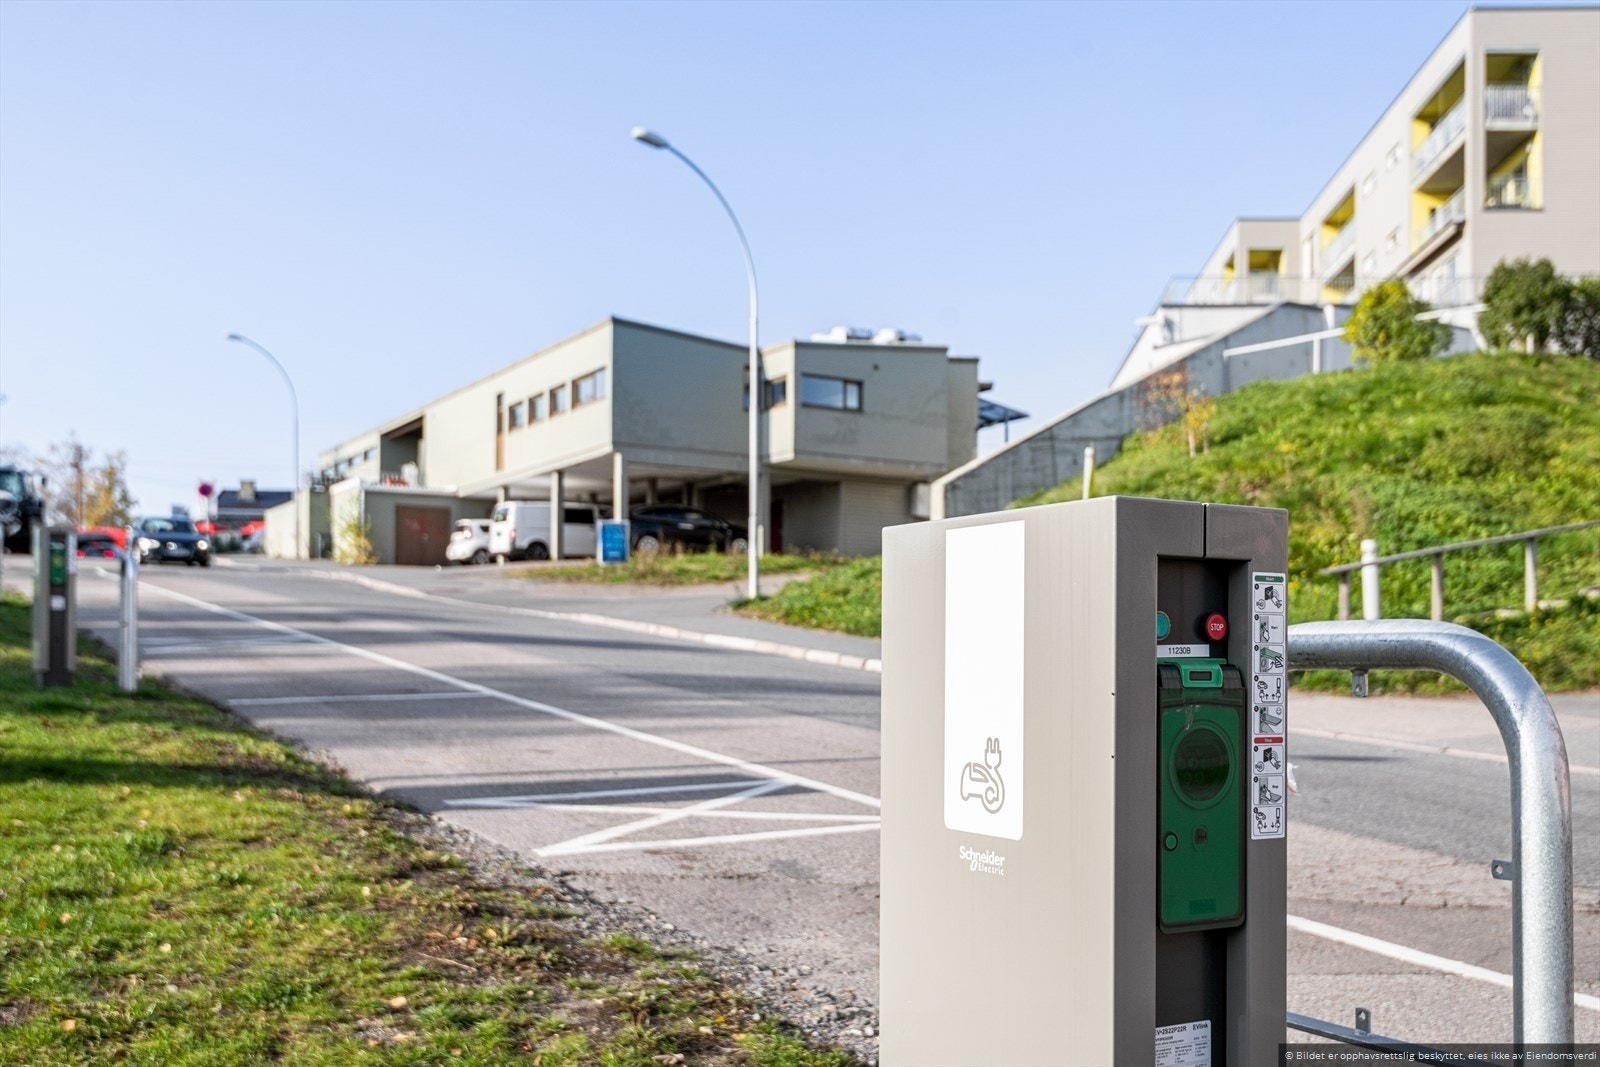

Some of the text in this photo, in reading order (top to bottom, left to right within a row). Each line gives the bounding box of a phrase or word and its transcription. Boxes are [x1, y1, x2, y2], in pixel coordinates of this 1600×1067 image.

[1210, 623, 1224, 631] STOP
[1168, 646, 1191, 655] 11230B
[959, 845, 1005, 867] Schneider
[978, 862, 1004, 876] Electric
